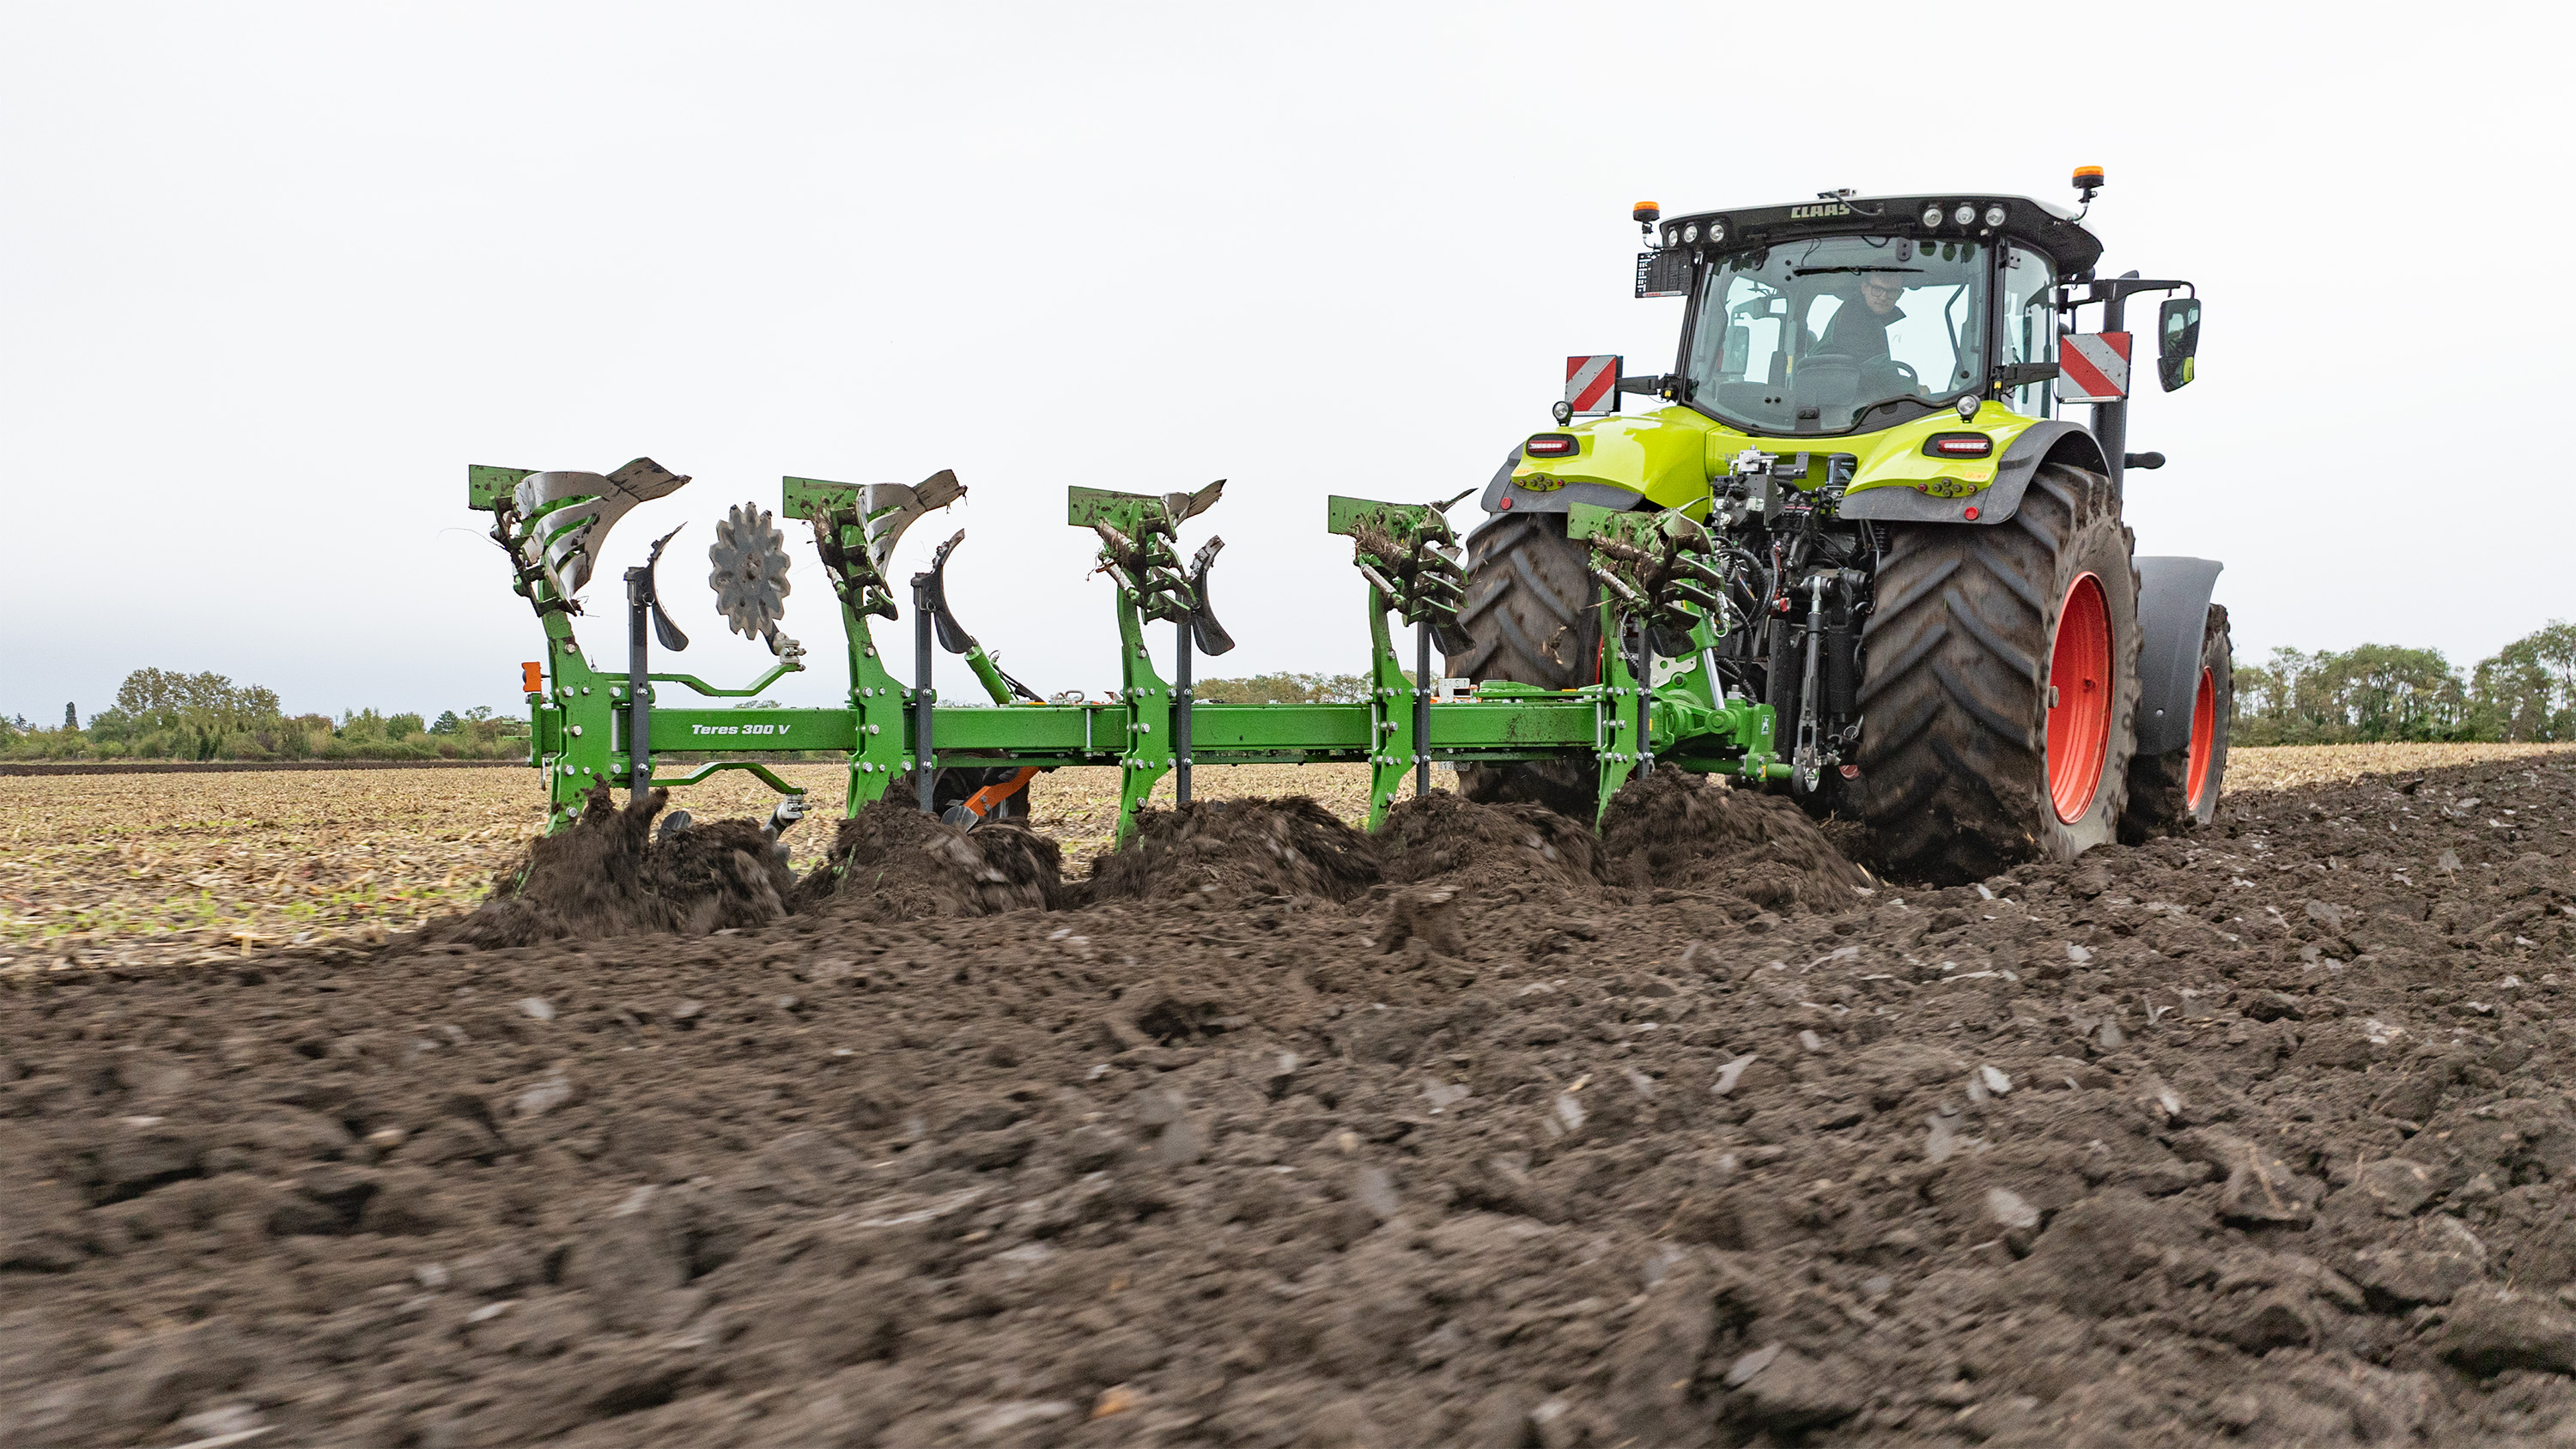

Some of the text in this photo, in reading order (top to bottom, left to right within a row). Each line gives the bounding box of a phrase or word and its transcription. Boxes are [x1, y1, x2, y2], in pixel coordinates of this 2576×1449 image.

[1790, 203, 1850, 219] CLAAS
[691, 724, 791, 735] Teres 300 V
